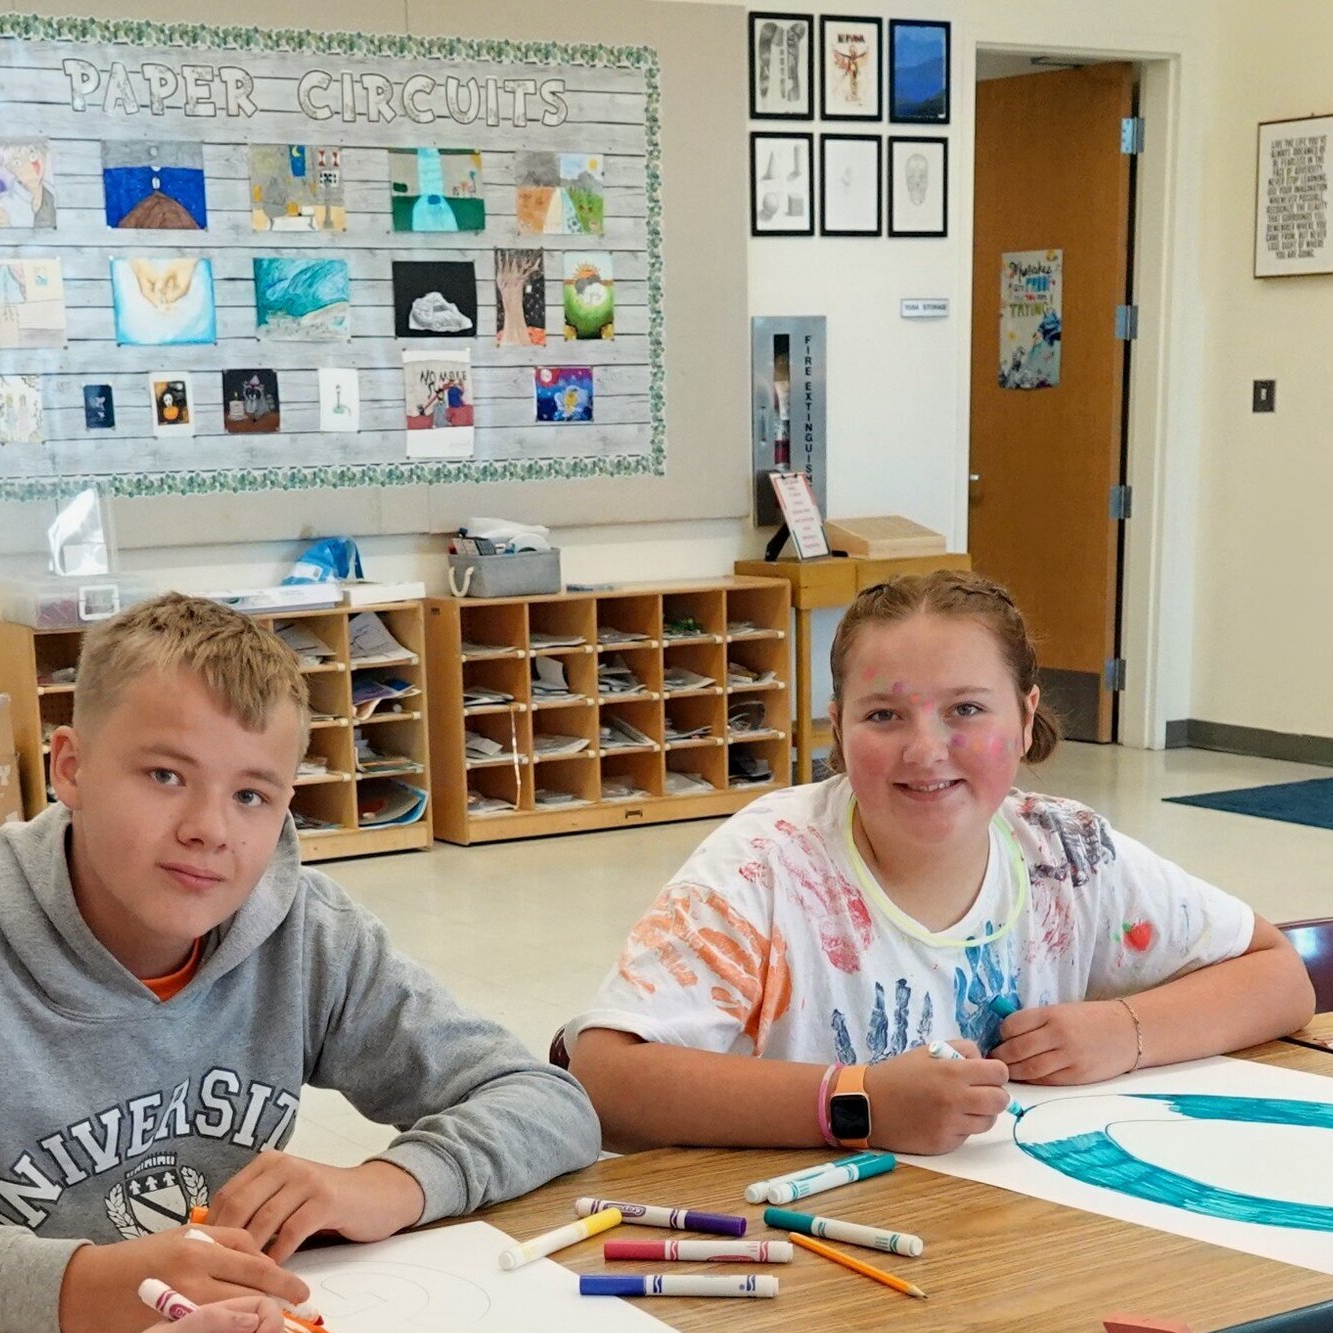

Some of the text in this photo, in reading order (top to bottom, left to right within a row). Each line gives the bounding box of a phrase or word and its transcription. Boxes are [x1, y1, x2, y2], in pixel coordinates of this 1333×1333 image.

[62, 58, 569, 128] PAPER CIRCUITS
[420, 370, 436, 385] NO
[804, 336, 812, 375] FIRE
[804, 383, 814, 487] EXTINGUISH
